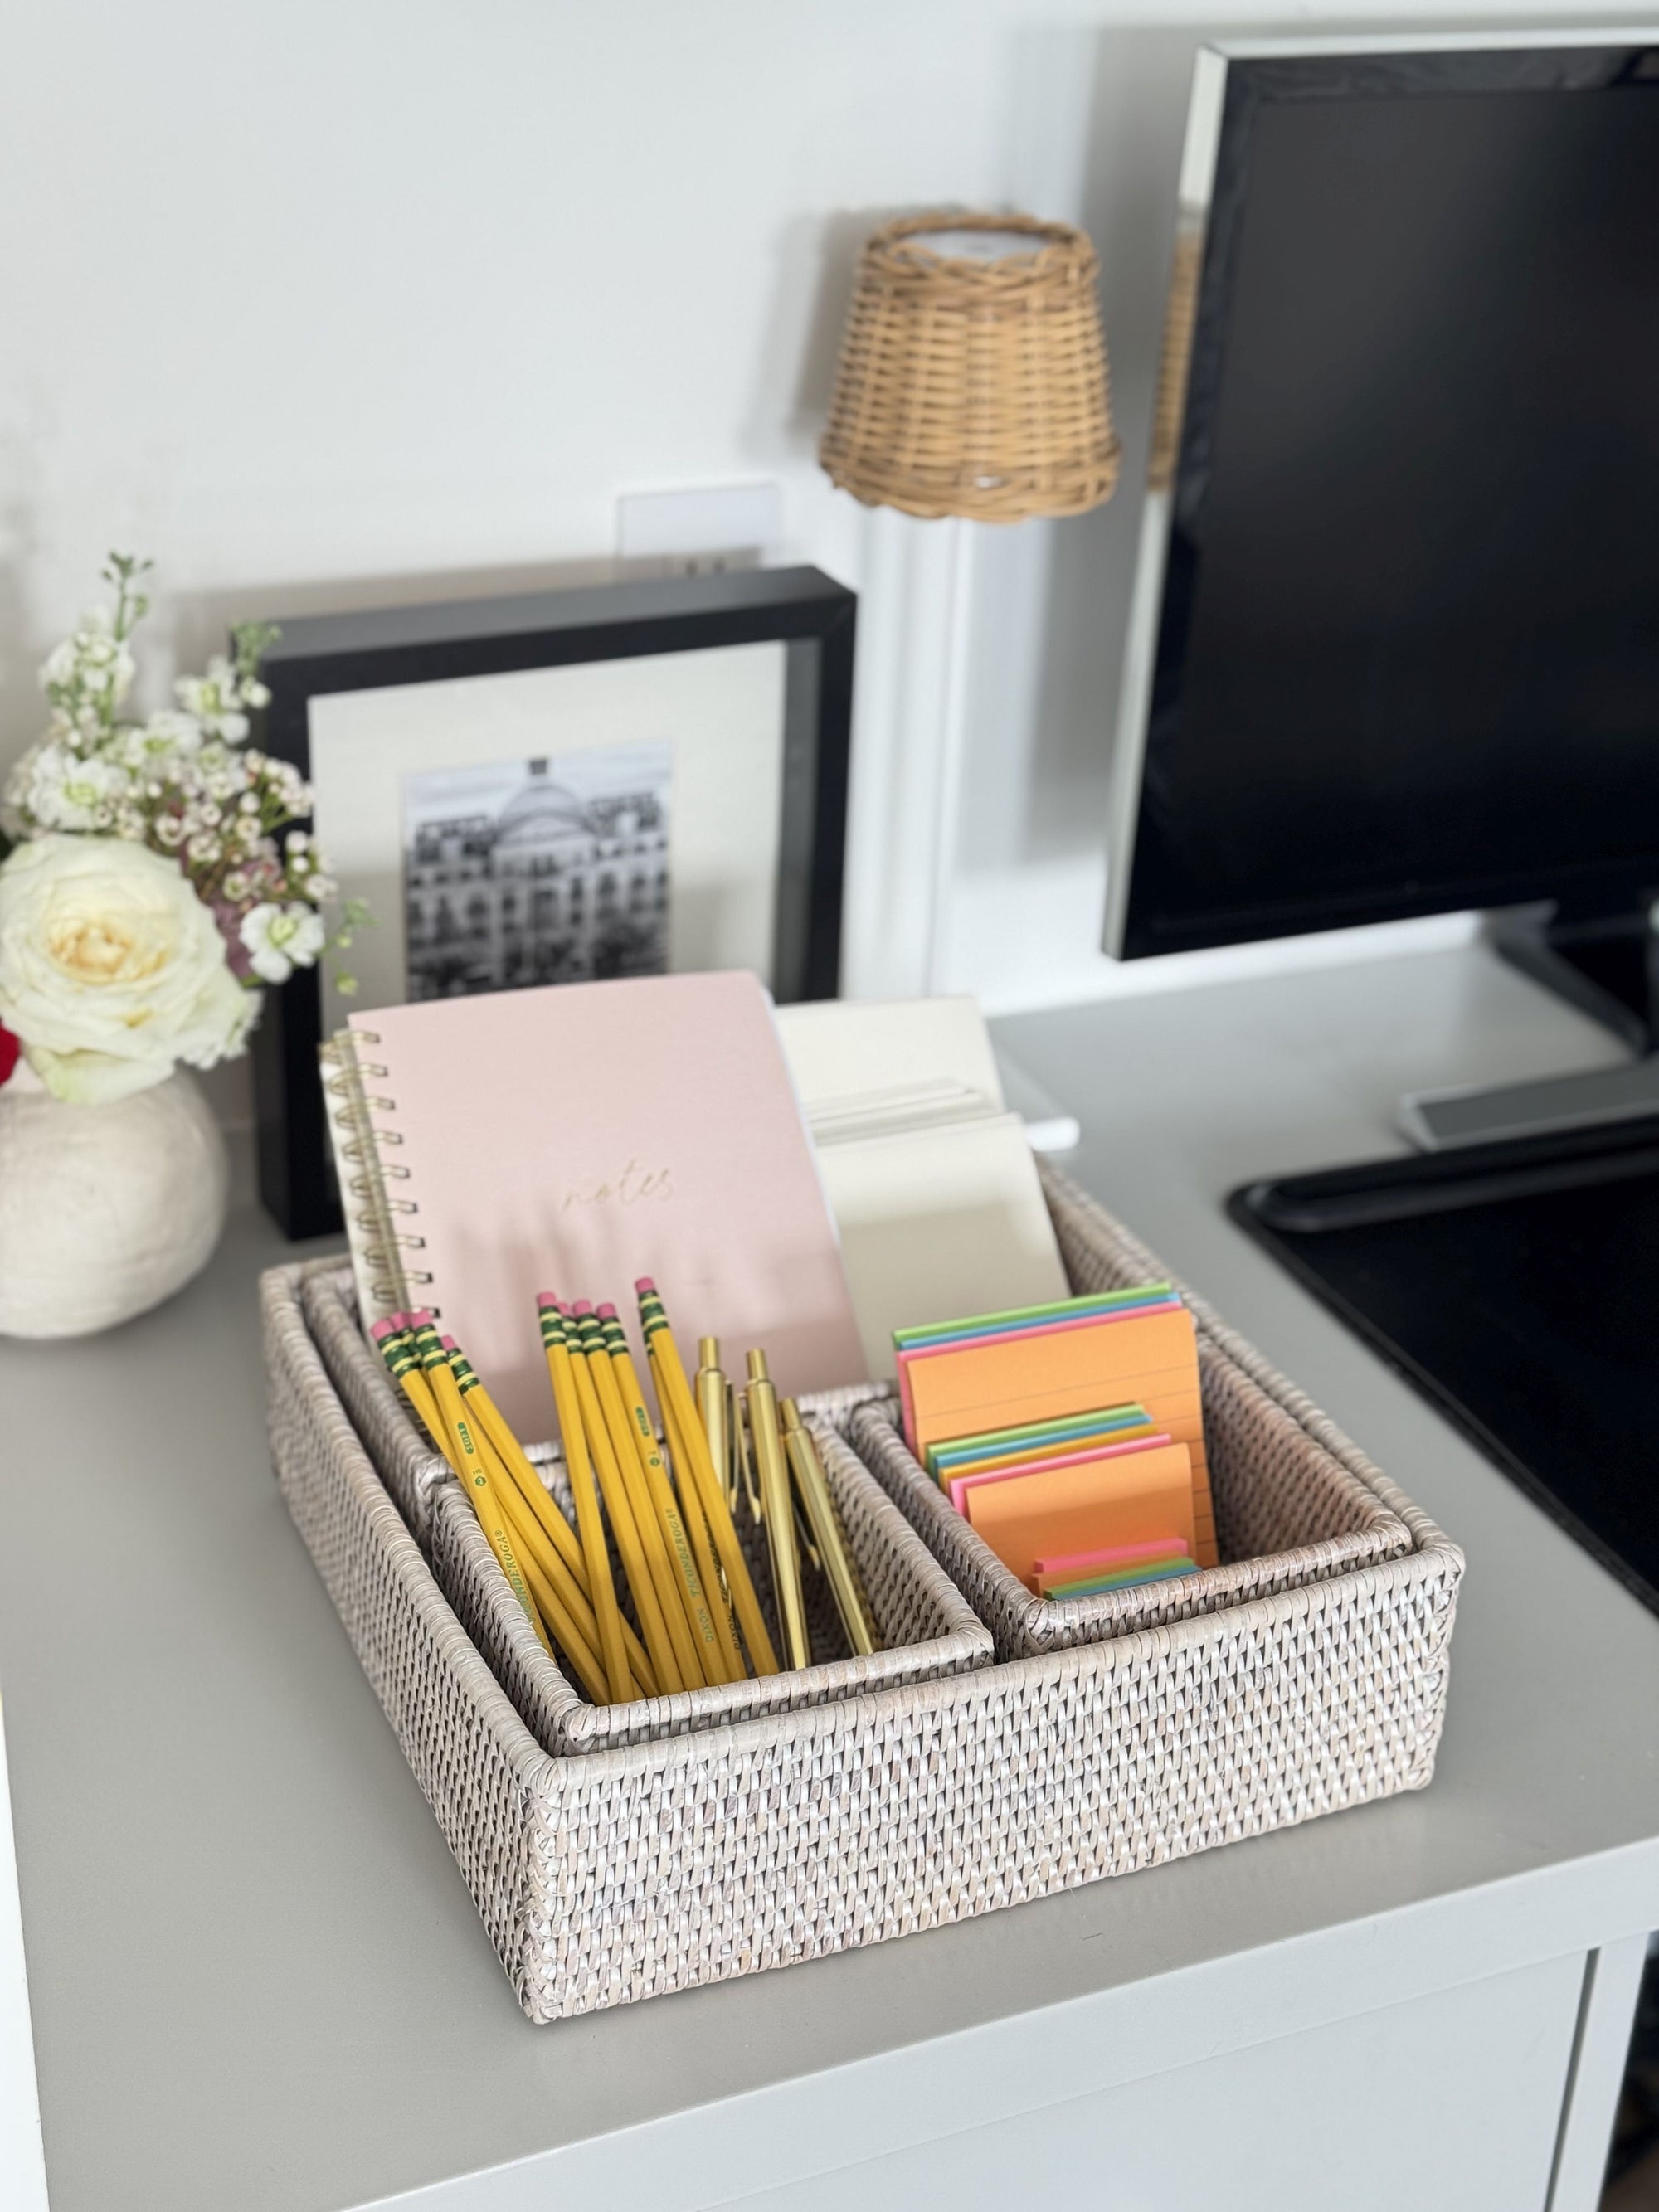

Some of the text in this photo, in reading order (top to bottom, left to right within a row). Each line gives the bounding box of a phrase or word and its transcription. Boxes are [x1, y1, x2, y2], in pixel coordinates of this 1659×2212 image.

[562, 1159, 674, 1210] notes
[460, 1427, 473, 1451] SOFT
[697, 1608, 714, 1642] DIXON
